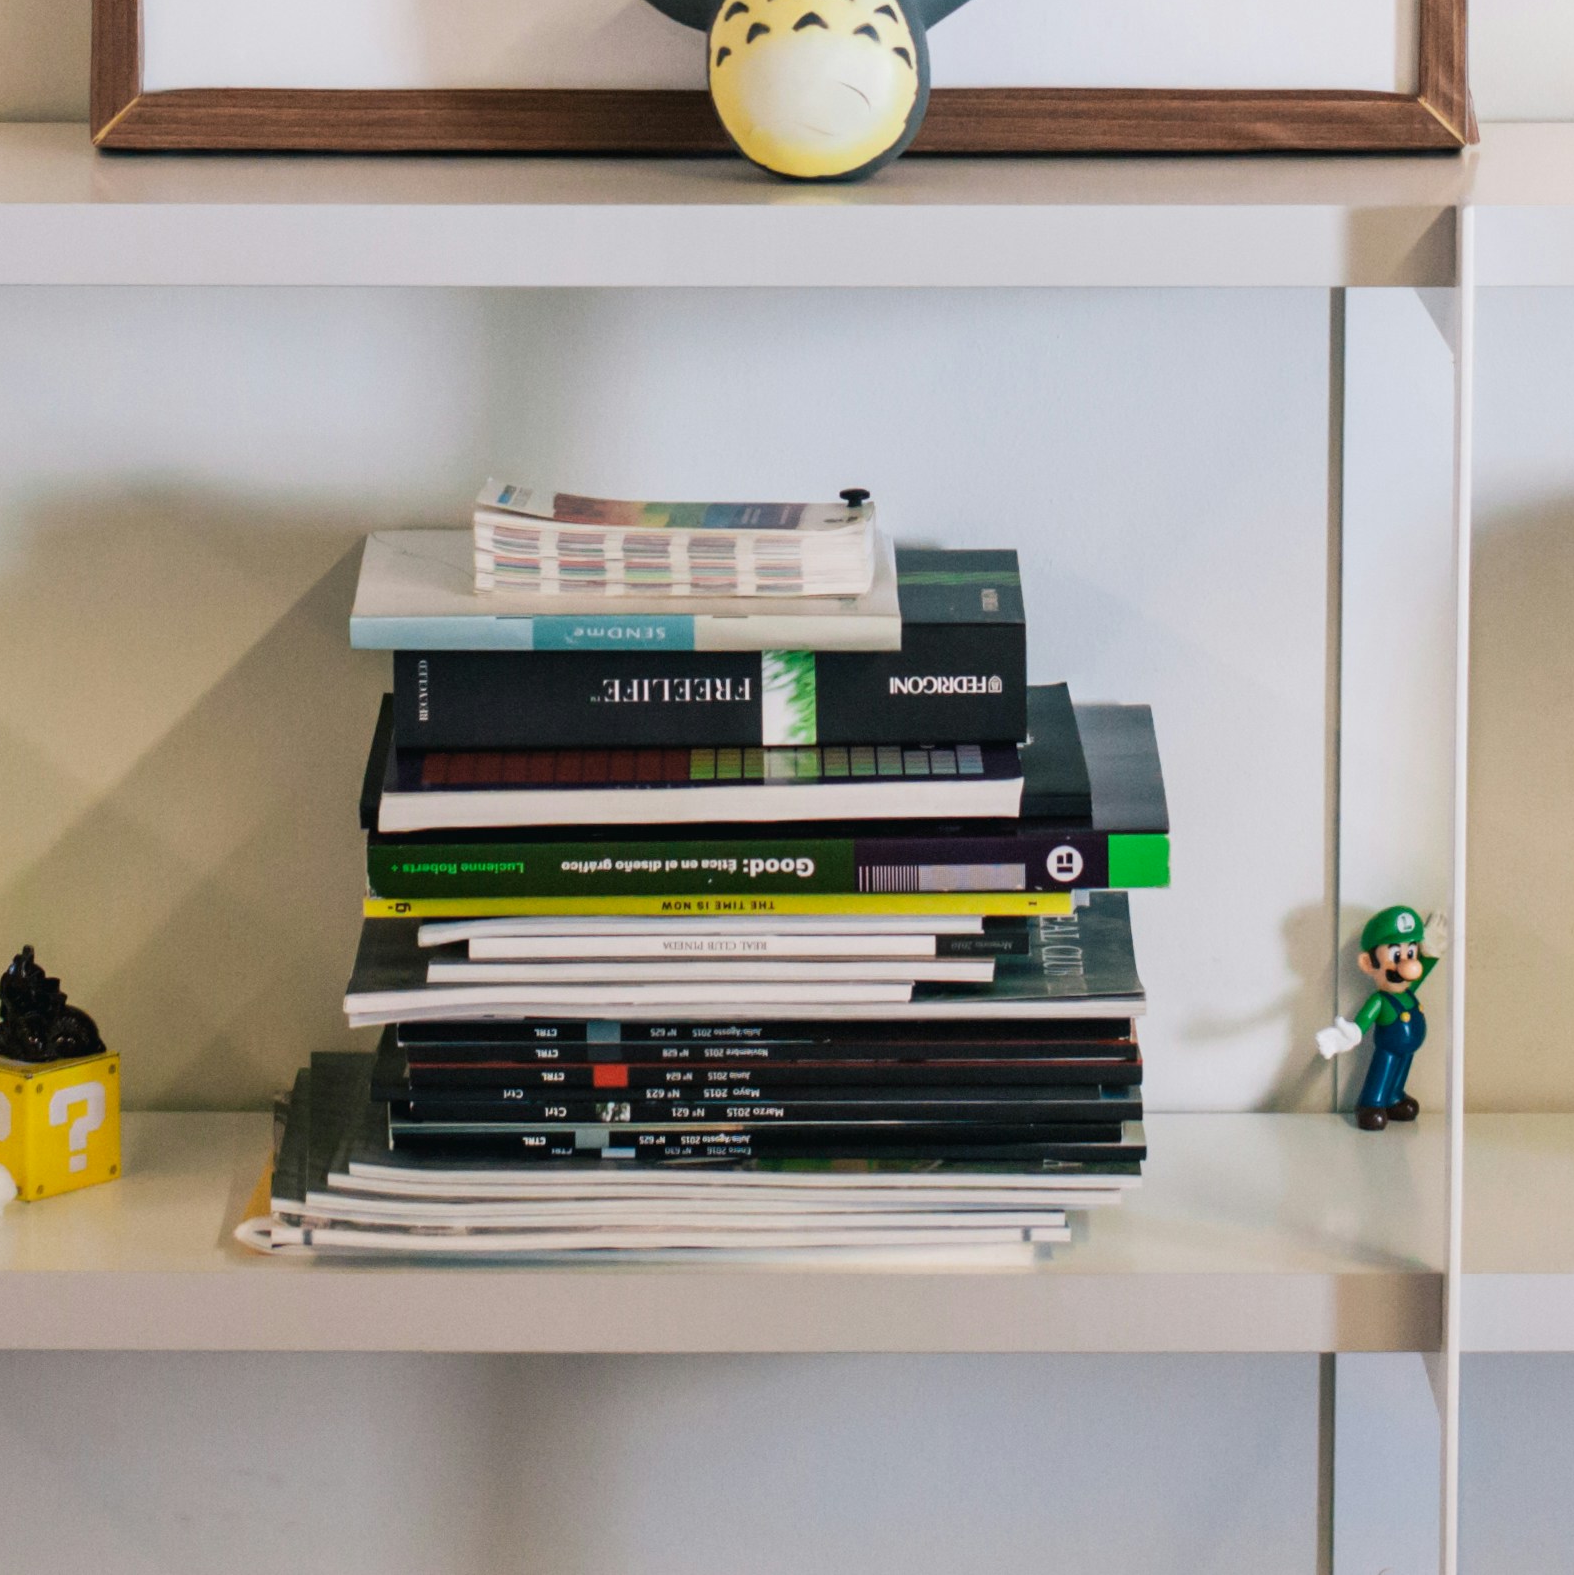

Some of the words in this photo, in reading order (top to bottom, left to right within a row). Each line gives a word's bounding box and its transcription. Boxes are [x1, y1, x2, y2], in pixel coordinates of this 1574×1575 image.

[574, 626, 666, 640] SENDme
[602, 678, 752, 702] FREELIFE
[889, 676, 987, 695] FEDRIGONI
[418, 660, 429, 722] RECYCLED
[402, 862, 458, 874] Roberts
[461, 862, 524, 874] Lucienne
[561, 858, 612, 873] gráfico
[615, 859, 662, 872] diseño
[665, 859, 678, 872] el
[681, 860, 698, 869] en
[702, 859, 737, 874] Ética
[743, 858, 815, 877] Good:
[661, 901, 691, 910] NOW
[697, 901, 709, 910] IS
[715, 901, 745, 910] TIME
[751, 901, 776, 910] THE
[1039, 913, 1080, 942] EAL
[662, 941, 704, 951] PINEDA
[707, 941, 736, 951] CLUB
[741, 941, 767, 951] REAL
[534, 1028, 558, 1037] CTRL
[650, 1028, 666, 1038] 625
[692, 1028, 711, 1038] 2015
[535, 1049, 559, 1058] CTRL
[704, 1048, 724, 1058] 2015
[725, 1048, 768, 1058] Noviembre
[541, 1072, 565, 1081] CTRL
[665, 1071, 681, 1080] 624
[707, 1071, 728, 1080] 2015
[729, 1071, 751, 1081] Junio
[504, 1089, 524, 1099] Ctrl
[646, 1088, 665, 1098] 623
[703, 1088, 728, 1098] 2015
[732, 1087, 760, 1098] Mayo
[545, 1107, 567, 1117] Ctrl
[672, 1107, 691, 1117] 621
[726, 1107, 750, 1117] 2015
[752, 1107, 784, 1117] Marzo
[522, 1137, 546, 1145] CTRL
[639, 1136, 654, 1145] 625
[681, 1136, 701, 1145] 2015
[728, 1147, 752, 1156] Enero
